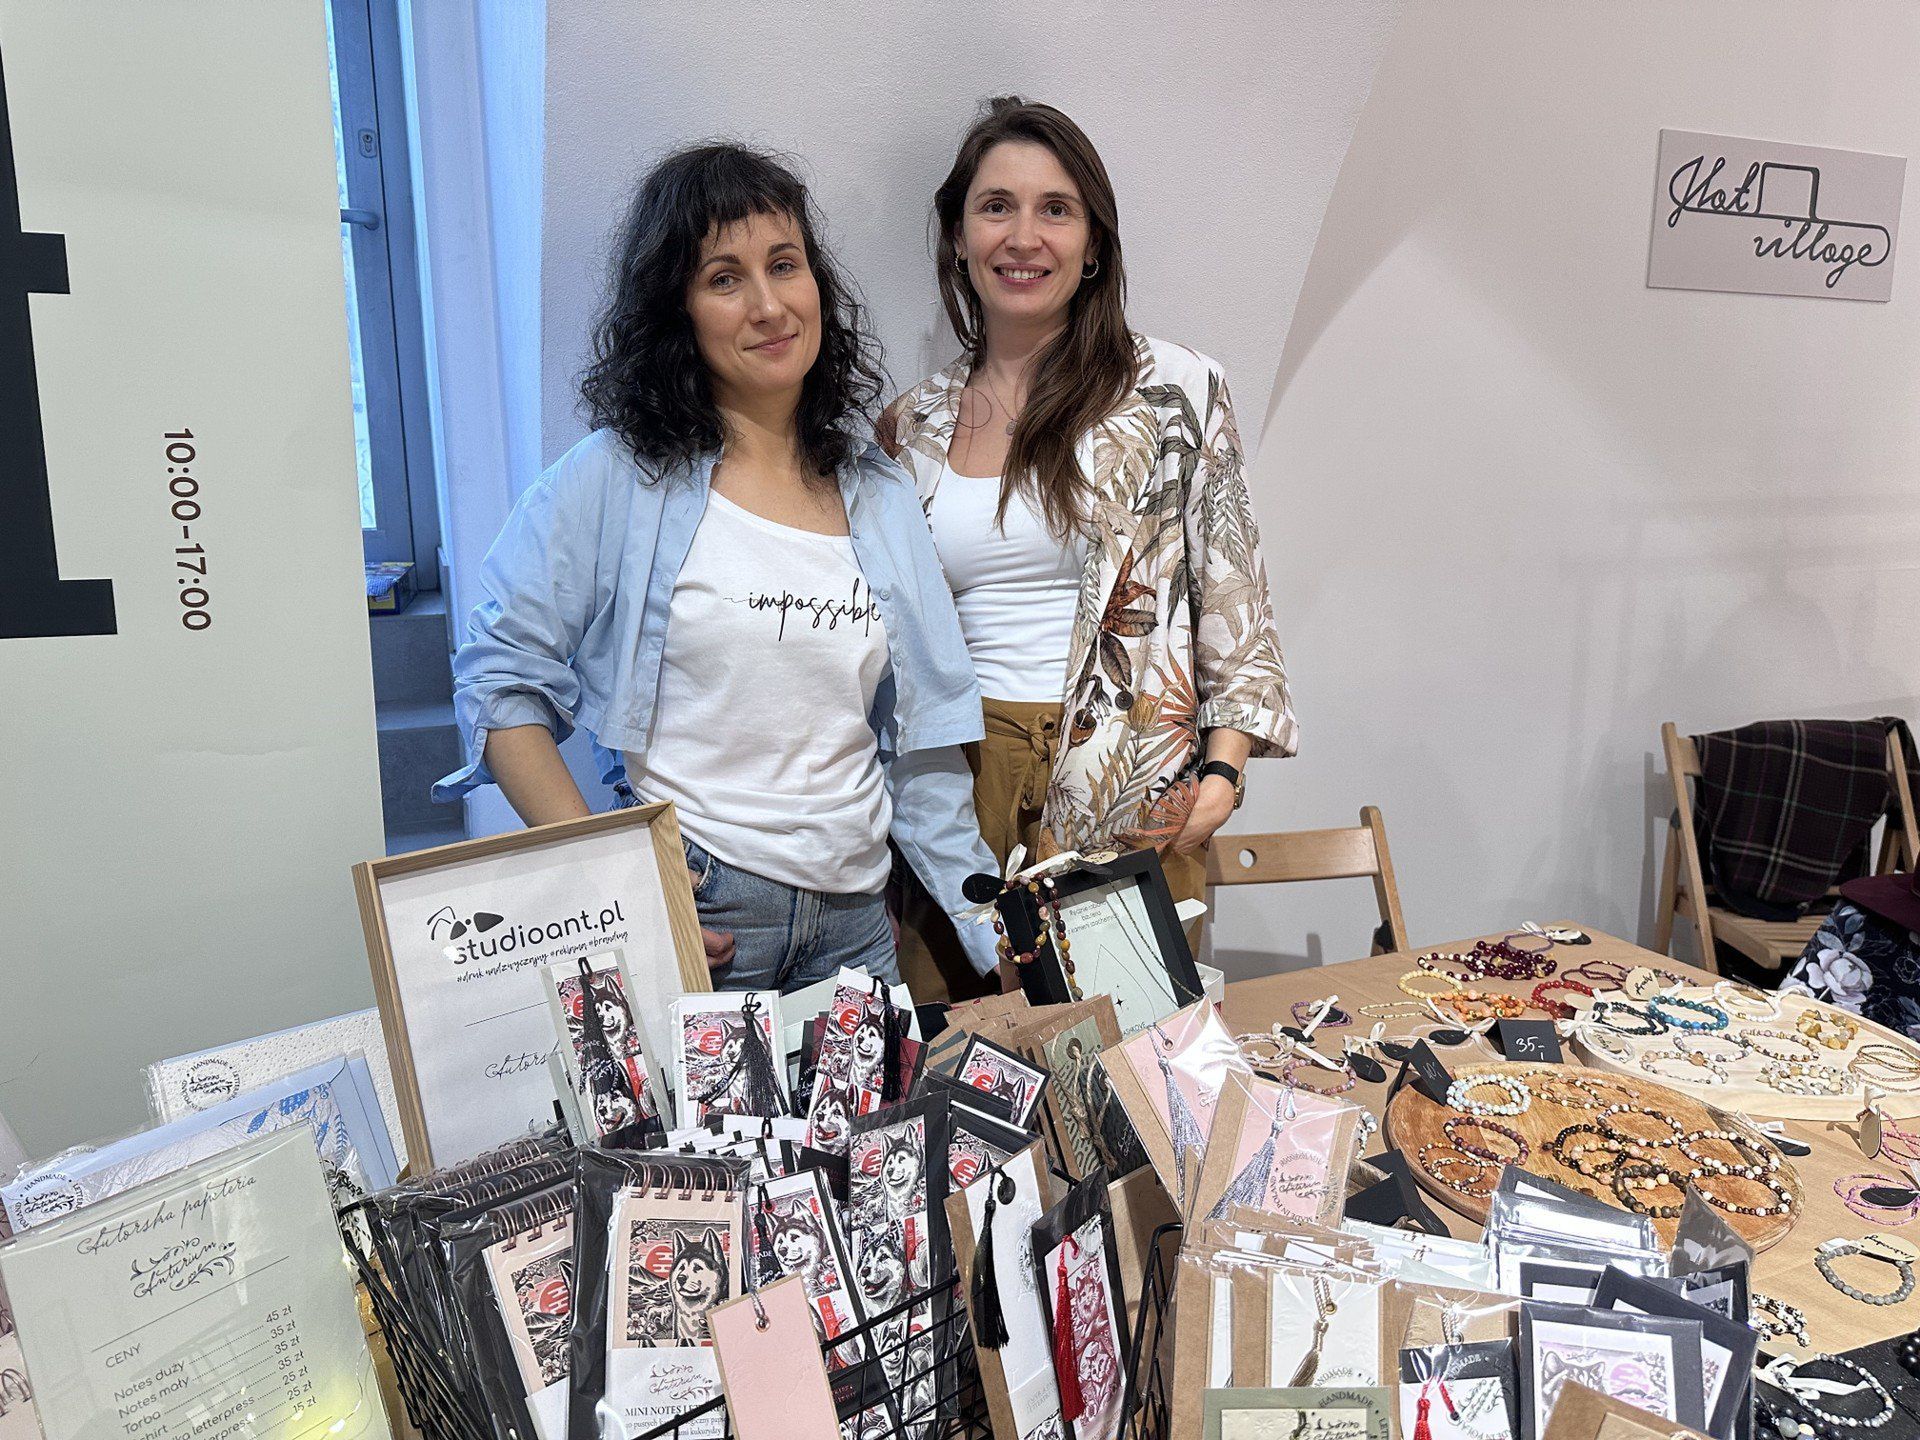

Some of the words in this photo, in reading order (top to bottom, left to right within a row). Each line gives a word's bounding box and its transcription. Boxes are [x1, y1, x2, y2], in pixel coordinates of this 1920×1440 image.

[1753, 219, 1880, 288] village
[163, 428, 212, 631] 10:00-17:00
[747, 577, 882, 642] impossible
[453, 900, 625, 964] studioant.pl
[24, 1173, 68, 1191] HANDMADE
[105, 1343, 141, 1368] CENY
[114, 1376, 152, 1402] Notes
[155, 1360, 185, 1381] duży
[266, 1310, 280, 1323] 45
[282, 1304, 292, 1316] zł
[118, 1394, 157, 1419] Notes
[159, 1376, 189, 1399] mały
[270, 1325, 284, 1339] 35
[286, 1319, 296, 1332] zł
[122, 1411, 161, 1435] Torba
[274, 1340, 288, 1355] 35
[290, 1334, 300, 1347] zł
[278, 1356, 292, 1370] 35
[294, 1349, 304, 1362] zł
[191, 1396, 255, 1436] letterpress
[282, 1371, 296, 1386] 25
[298, 1364, 308, 1377] zł
[287, 1386, 301, 1400] 25
[302, 1379, 312, 1392] zł
[307, 1395, 317, 1407] zł
[624, 1407, 648, 1417] MINI
[650, 1405, 680, 1415] NOTES
[1319, 1391, 1374, 1408] HANDMADE
